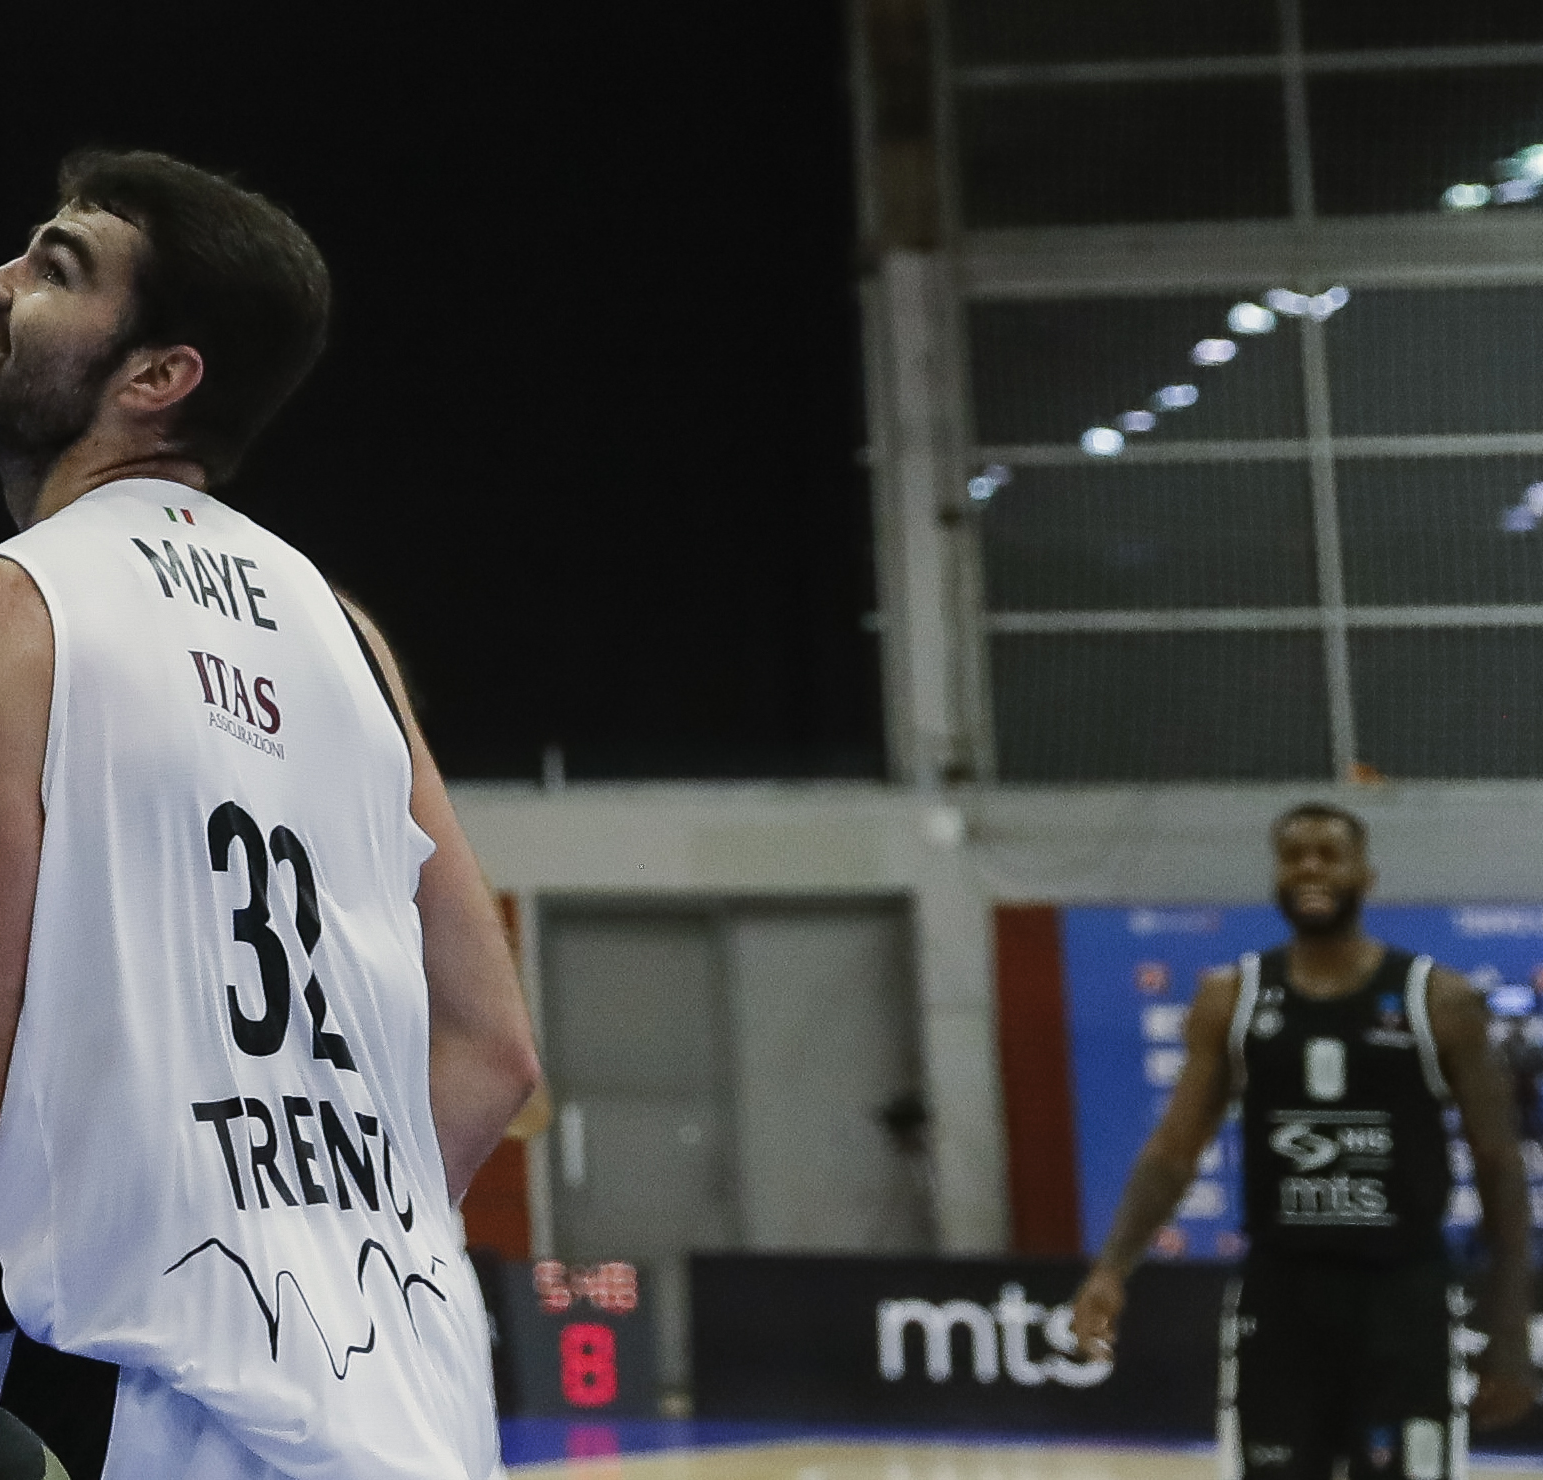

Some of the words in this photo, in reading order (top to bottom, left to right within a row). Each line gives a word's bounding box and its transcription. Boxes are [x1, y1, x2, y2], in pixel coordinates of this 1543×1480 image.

[130, 537, 278, 632] MAYE
[188, 650, 282, 734] ITAS
[207, 800, 359, 1073] 32
[560, 1323, 618, 1408] 8
